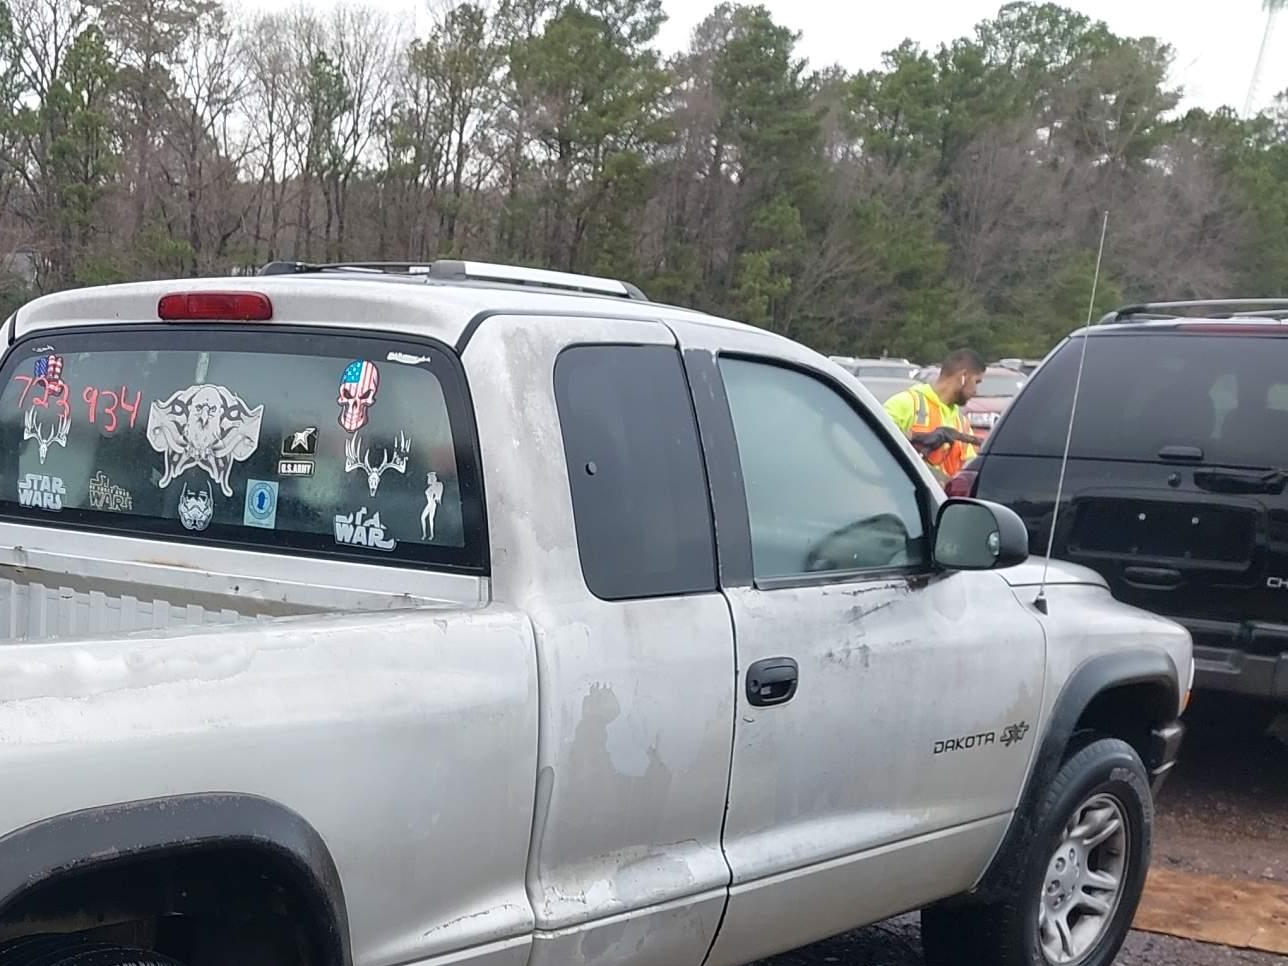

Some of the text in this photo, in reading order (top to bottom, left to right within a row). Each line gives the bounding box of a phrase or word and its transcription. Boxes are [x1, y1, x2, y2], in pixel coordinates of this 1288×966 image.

[14, 375, 142, 432] 723 934
[18, 473, 66, 495] STAR
[933, 732, 995, 754] DAKOTA
